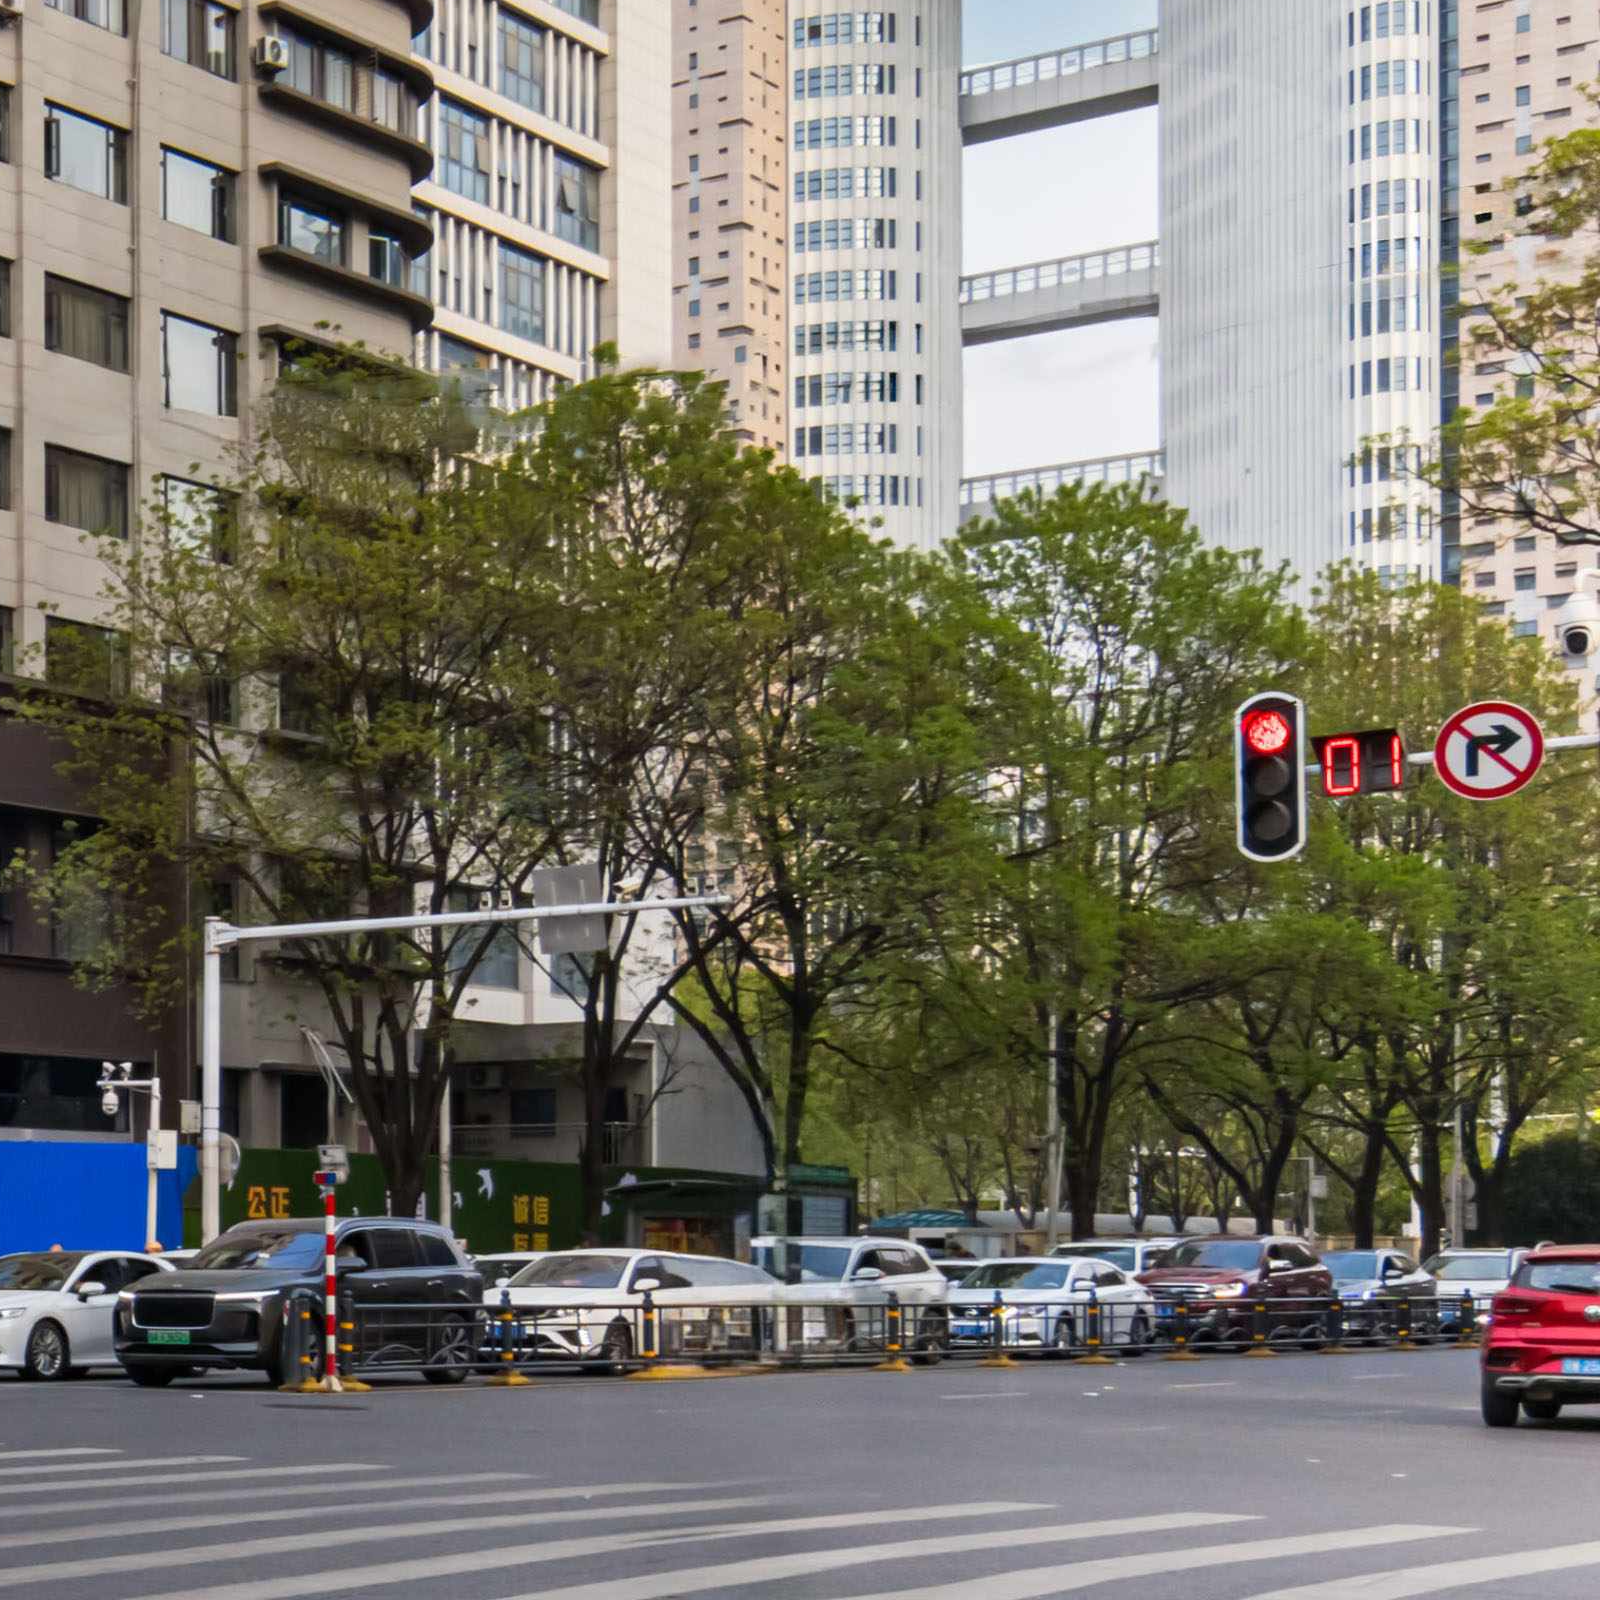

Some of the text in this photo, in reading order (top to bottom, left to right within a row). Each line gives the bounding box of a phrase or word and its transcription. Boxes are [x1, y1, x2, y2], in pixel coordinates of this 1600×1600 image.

[1324, 735, 1401, 796] 01
[248, 1186, 290, 1218] 公正
[513, 1195, 548, 1225] 诚信
